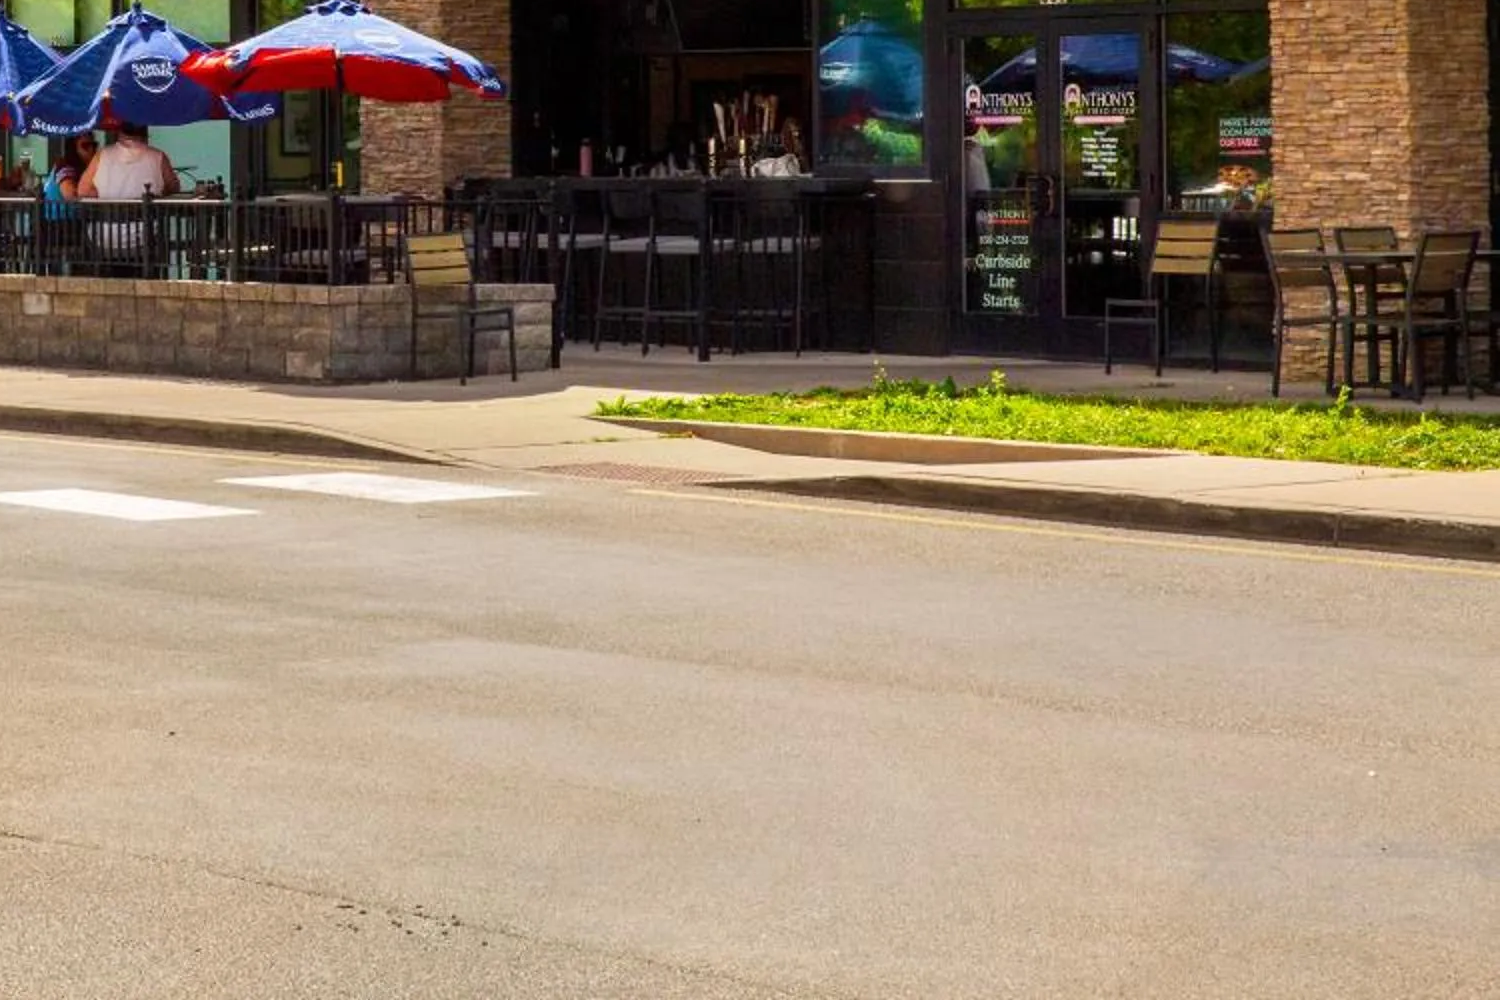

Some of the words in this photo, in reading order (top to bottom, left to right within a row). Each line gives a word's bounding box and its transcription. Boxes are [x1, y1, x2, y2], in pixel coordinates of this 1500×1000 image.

[975, 253, 1032, 269] Curbside
[989, 273, 1016, 288] Line
[982, 293, 1021, 308] Starts
